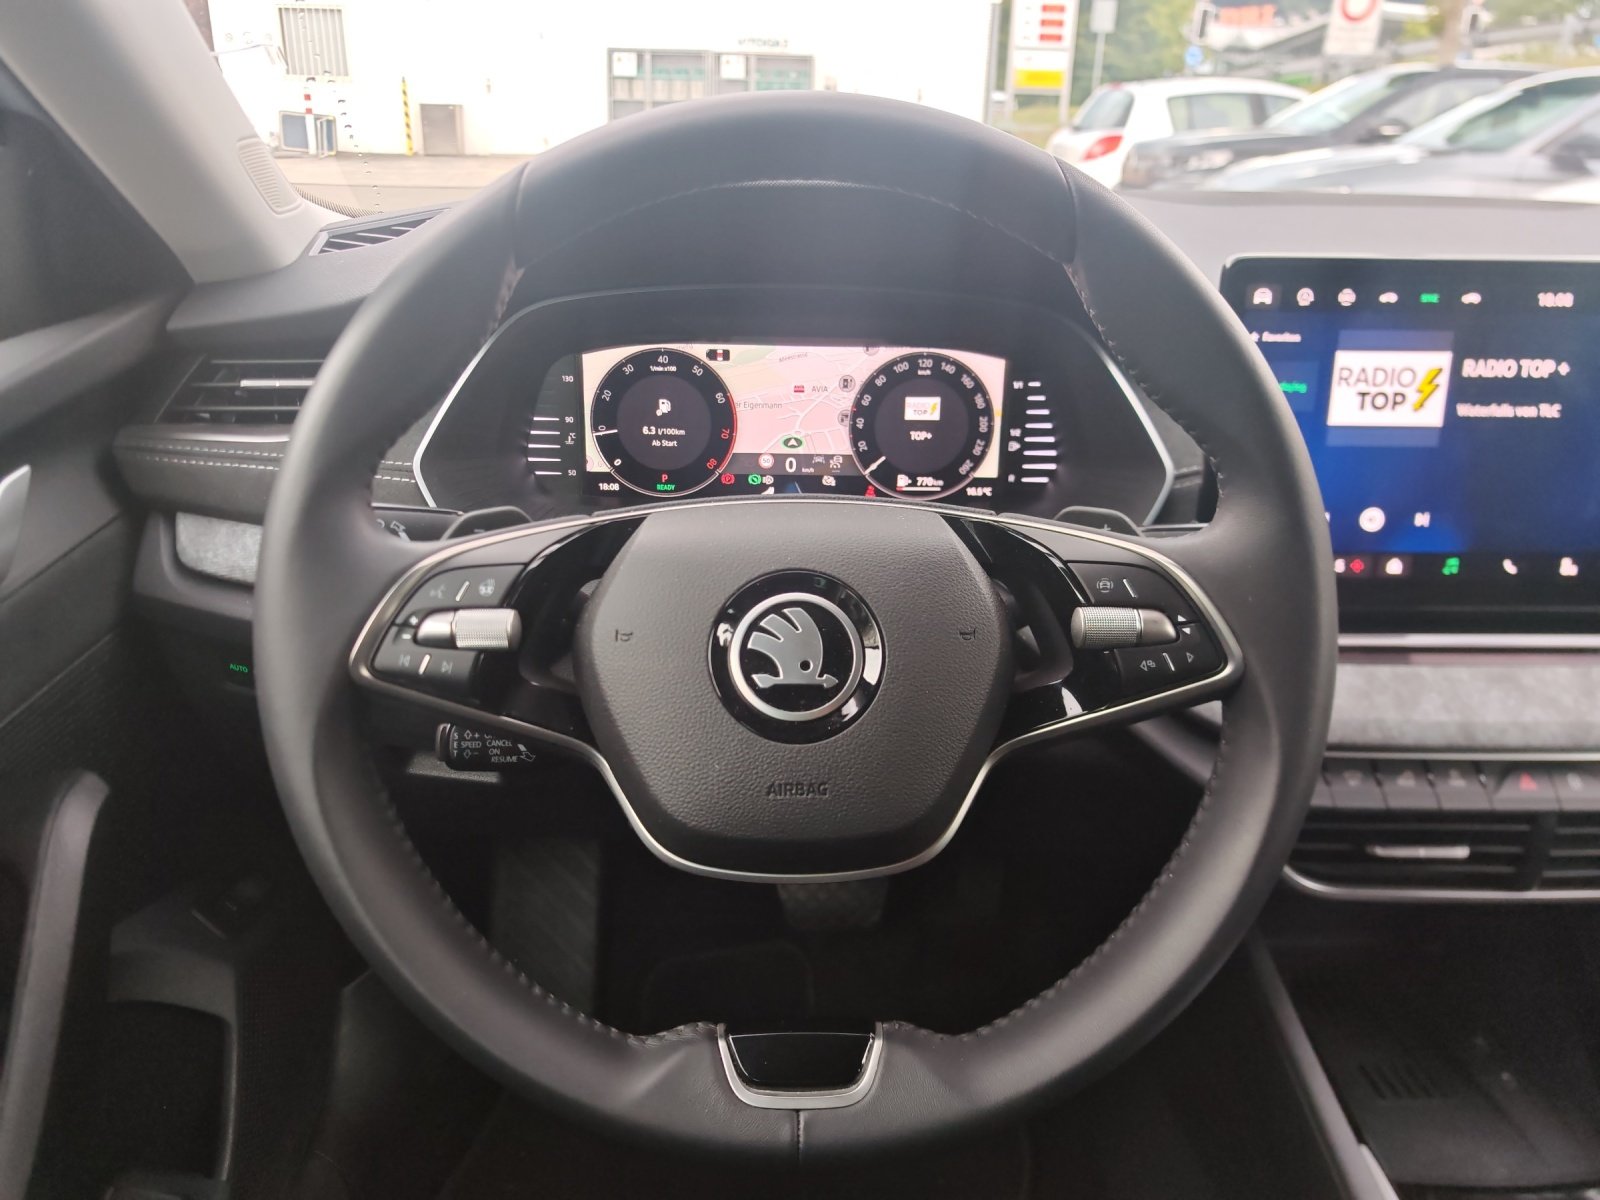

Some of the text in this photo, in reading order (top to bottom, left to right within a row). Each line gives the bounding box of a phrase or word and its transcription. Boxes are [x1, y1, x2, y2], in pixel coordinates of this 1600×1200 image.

[657, 355, 669, 364] 40
[917, 359, 933, 368] 120
[622, 364, 634, 375] 30
[691, 365, 703, 376] 50
[893, 361, 910, 374] 100
[940, 361, 956, 374] 140
[1462, 358, 1518, 378] RADIO
[1519, 358, 1557, 378] TOP
[874, 375, 887, 387] 80
[960, 374, 975, 389] 160
[1338, 367, 1417, 388] RADIO
[601, 389, 612, 401] 20
[811, 385, 829, 393] AVIA
[715, 392, 725, 404] 60
[861, 394, 872, 407] 60
[974, 393, 986, 410] 180
[1357, 392, 1406, 412] TOP
[743, 401, 783, 410] Eigenmann
[856, 417, 865, 429] 40
[979, 416, 988, 433] 200
[643, 426, 655, 435] 6.3
[721, 428, 730, 439] 70
[652, 439, 678, 447] Ab Start
[858, 440, 868, 452] 20
[613, 458, 622, 467] 0
[706, 458, 718, 470] 80
[785, 457, 797, 473] 0
[661, 474, 668, 482] P
[598, 483, 619, 491] 18:08
[230, 663, 248, 673] AUTO
[460, 741, 481, 749] SPEED
[489, 748, 501, 756] ON
[491, 755, 518, 763] RESUME
[766, 782, 829, 798] AIRBAG
